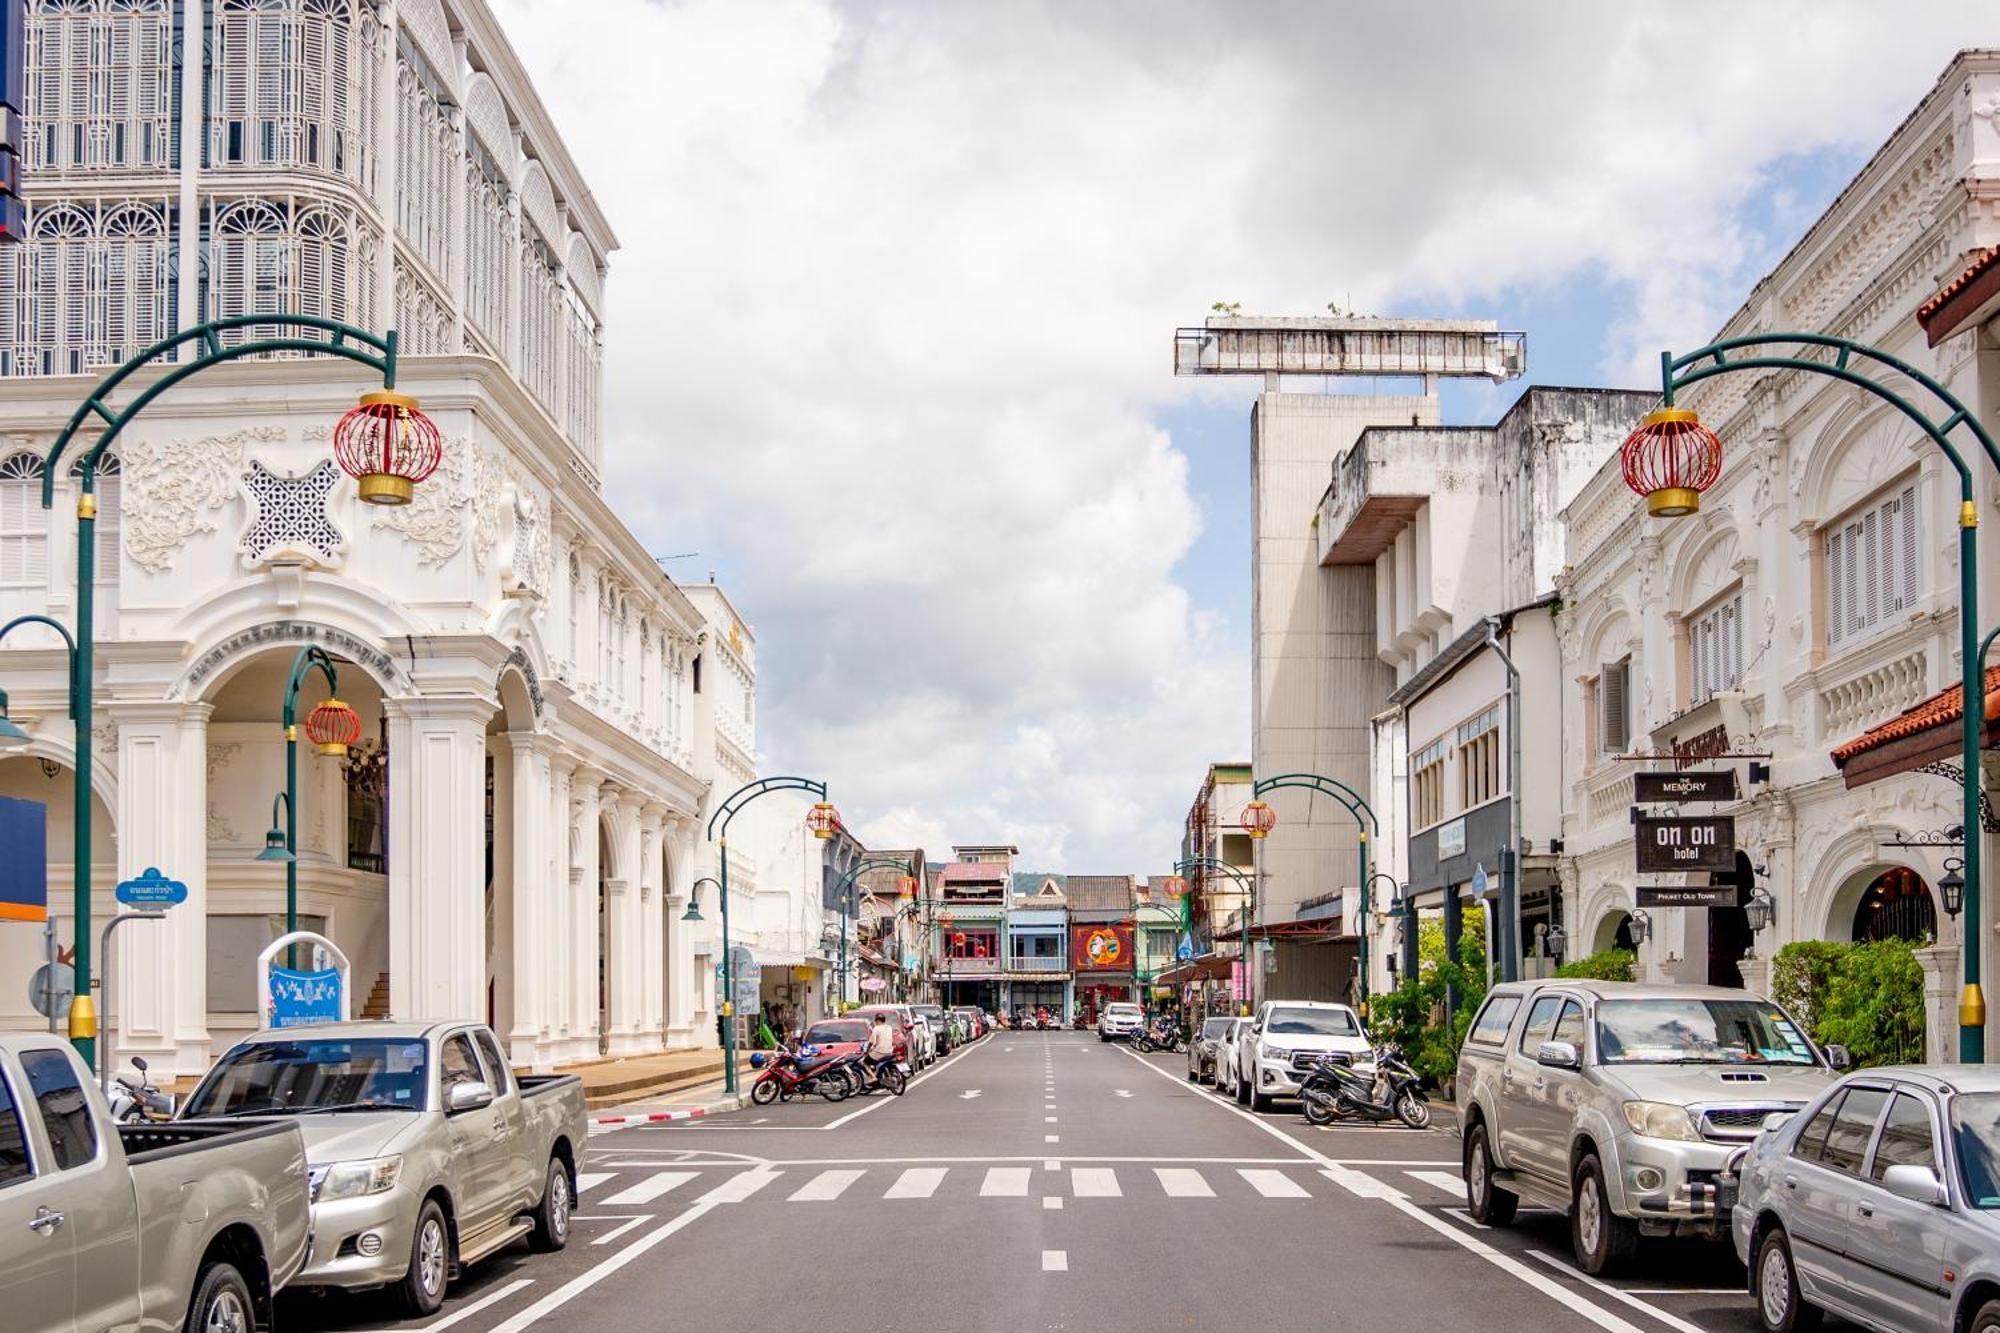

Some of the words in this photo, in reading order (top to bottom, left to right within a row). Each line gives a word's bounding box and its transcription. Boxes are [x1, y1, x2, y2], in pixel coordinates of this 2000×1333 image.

[1663, 782, 1706, 792] MEMORY
[1656, 826, 1681, 846] on
[1691, 825, 1715, 845] on
[1674, 847, 1699, 860] hotel
